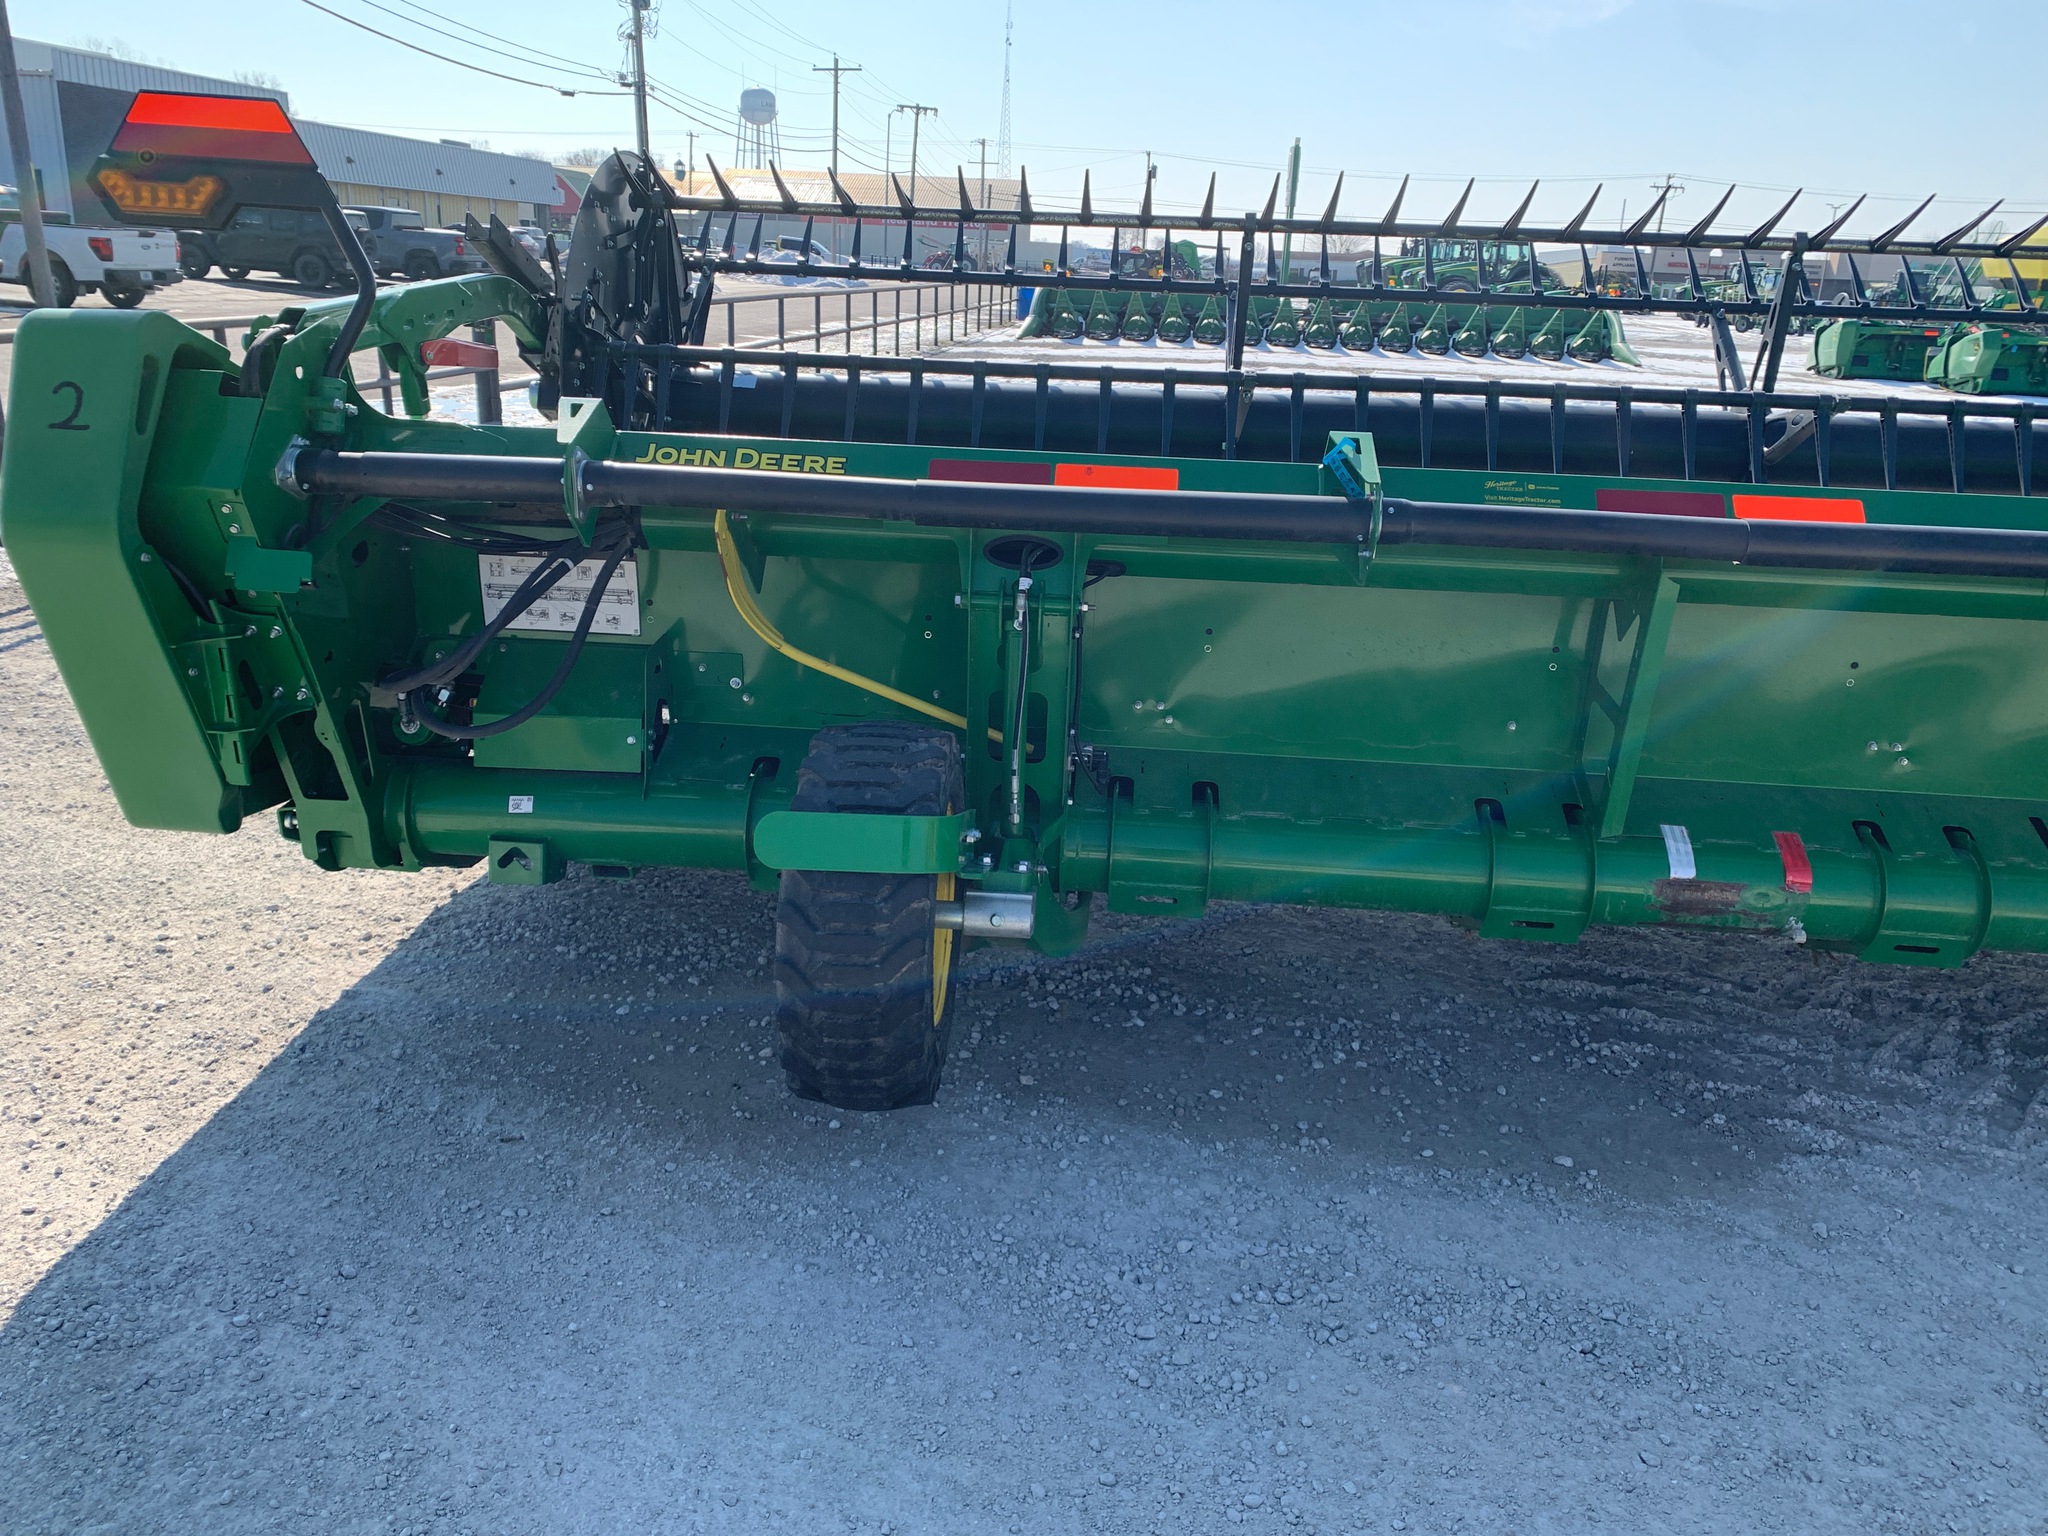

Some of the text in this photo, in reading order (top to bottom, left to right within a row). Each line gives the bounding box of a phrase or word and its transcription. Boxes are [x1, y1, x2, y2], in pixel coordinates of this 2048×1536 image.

[48, 380, 91, 431] 2
[635, 442, 847, 475] JOHN DEERE
